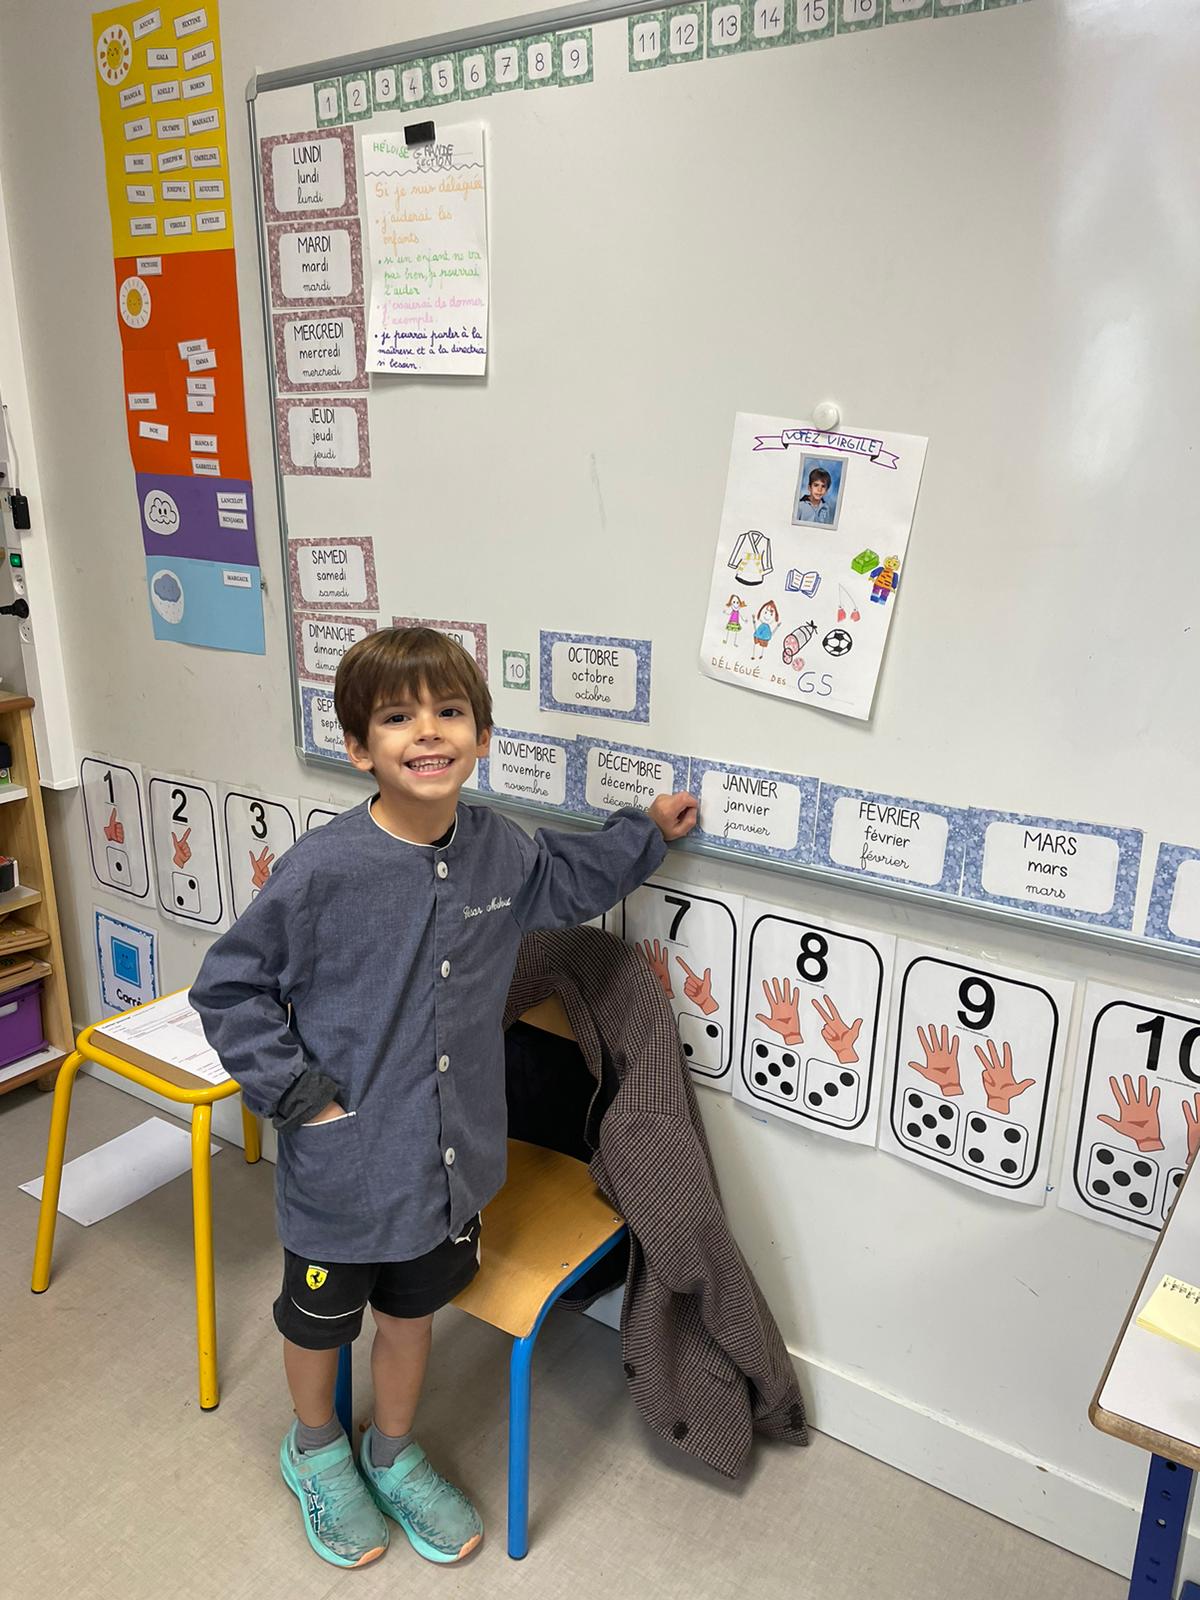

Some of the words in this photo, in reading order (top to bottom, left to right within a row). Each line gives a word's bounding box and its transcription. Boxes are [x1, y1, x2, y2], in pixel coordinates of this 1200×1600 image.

[760, 7, 781, 30] 14
[803, 0, 826, 23] 15
[676, 23, 696, 46] 12
[718, 15, 738, 37] 13
[638, 32, 656, 53] 11
[502, 56, 512, 76] 7
[535, 52, 545, 72] 8
[570, 49, 580, 69] 9
[438, 69, 448, 88] 5
[470, 64, 480, 82] 6
[382, 78, 390, 96] 3
[409, 77, 417, 95] 4
[325, 96, 331, 112] 1
[352, 89, 362, 106] 2
[293, 145, 322, 165] LUNDI
[297, 167, 319, 184] lundi
[297, 187, 323, 204] lundi
[375, 182, 389, 198] Si
[394, 187, 406, 210] je
[438, 205, 452, 220] les
[297, 236, 331, 254] MARDI
[302, 257, 329, 273] mardi
[303, 280, 331, 292] mardi
[293, 322, 344, 341] MERCREDI
[381, 327, 390, 345] je
[394, 328, 428, 348] pourrai
[430, 327, 460, 347] parler
[461, 326, 468, 338] à
[472, 326, 482, 338] la
[299, 343, 341, 359] mercredi
[438, 345, 449, 354] la
[302, 365, 342, 378] mercredi
[309, 408, 335, 424] JEUDI
[312, 428, 333, 445] jeudi
[785, 431, 821, 444] VOTEZ
[827, 434, 878, 453] VIRGILE
[313, 449, 336, 468] jeudi
[312, 550, 348, 564] SAMEDI
[316, 568, 346, 581] samedi
[318, 588, 350, 598] samedi
[309, 624, 356, 643] DIMANCHE
[568, 647, 619, 668] OCTOBRE
[510, 664, 525, 678] 10
[572, 668, 614, 685] octobre
[770, 675, 787, 686] DES
[798, 671, 833, 696] GS
[575, 685, 611, 703] octobre
[498, 740, 557, 764] NOVEMBRE
[502, 763, 551, 780] novembre
[598, 751, 662, 780] DÉCEMBRE
[104, 770, 115, 803] 1
[504, 780, 549, 797] novembre
[600, 775, 655, 796] décembre
[722, 774, 778, 799] JANVIER
[171, 788, 188, 823] 2
[723, 796, 770, 816] janvier
[250, 802, 268, 839] 3
[858, 800, 920, 831] FÉVRIER
[723, 819, 771, 838] janvier
[864, 825, 911, 849] février
[1023, 830, 1078, 856] MARS
[860, 842, 910, 870] février
[1027, 860, 1069, 878] mars
[1025, 883, 1067, 900] mars
[664, 895, 691, 941] 7
[796, 932, 828, 982] 8
[957, 976, 996, 1030] 9
